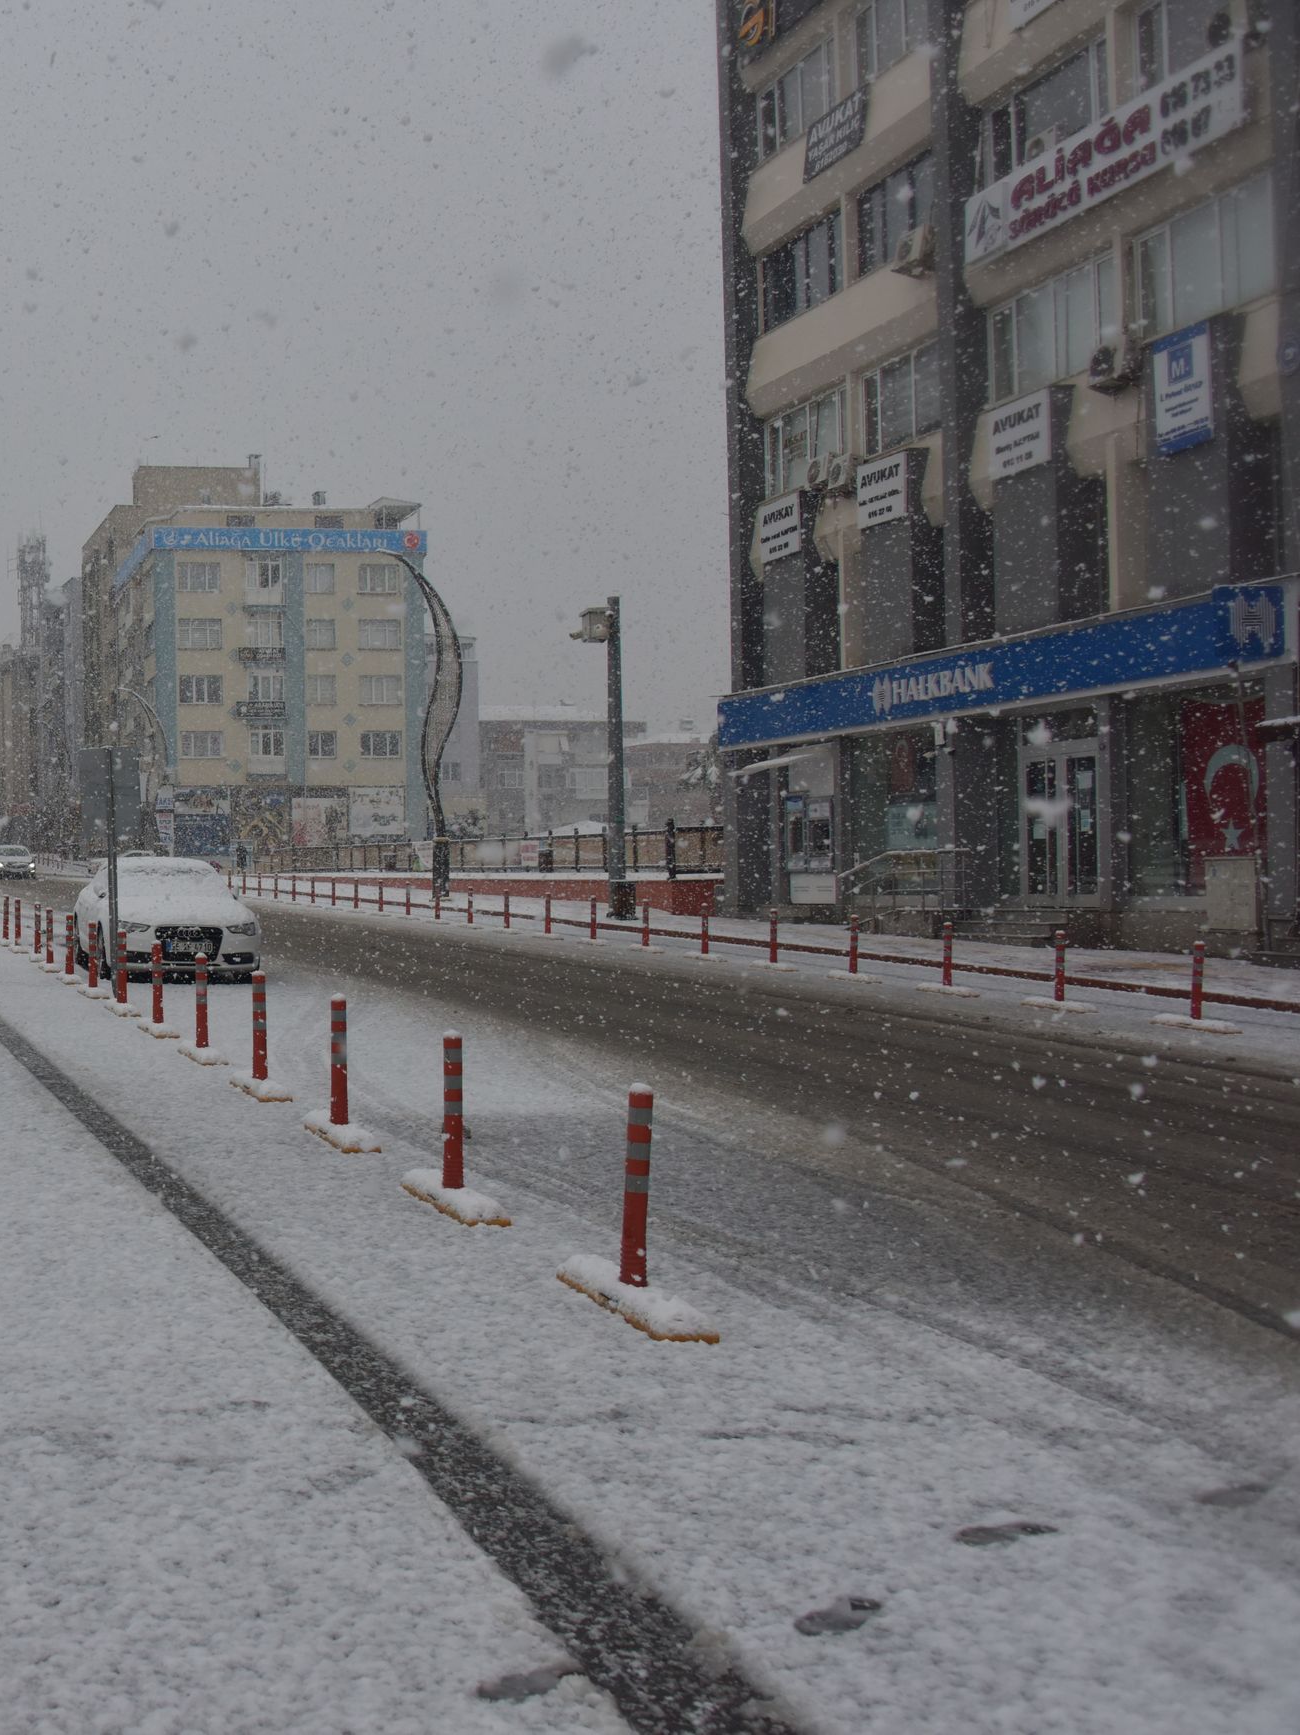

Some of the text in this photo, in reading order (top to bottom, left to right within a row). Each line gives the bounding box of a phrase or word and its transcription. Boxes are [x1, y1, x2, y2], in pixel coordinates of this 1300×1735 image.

[808, 91, 862, 146] AVUKAT
[993, 402, 1041, 436] AVUKAT
[860, 463, 900, 489] AVUKAT
[763, 504, 794, 527] AVUKAT
[892, 661, 995, 705] HALKBANK
